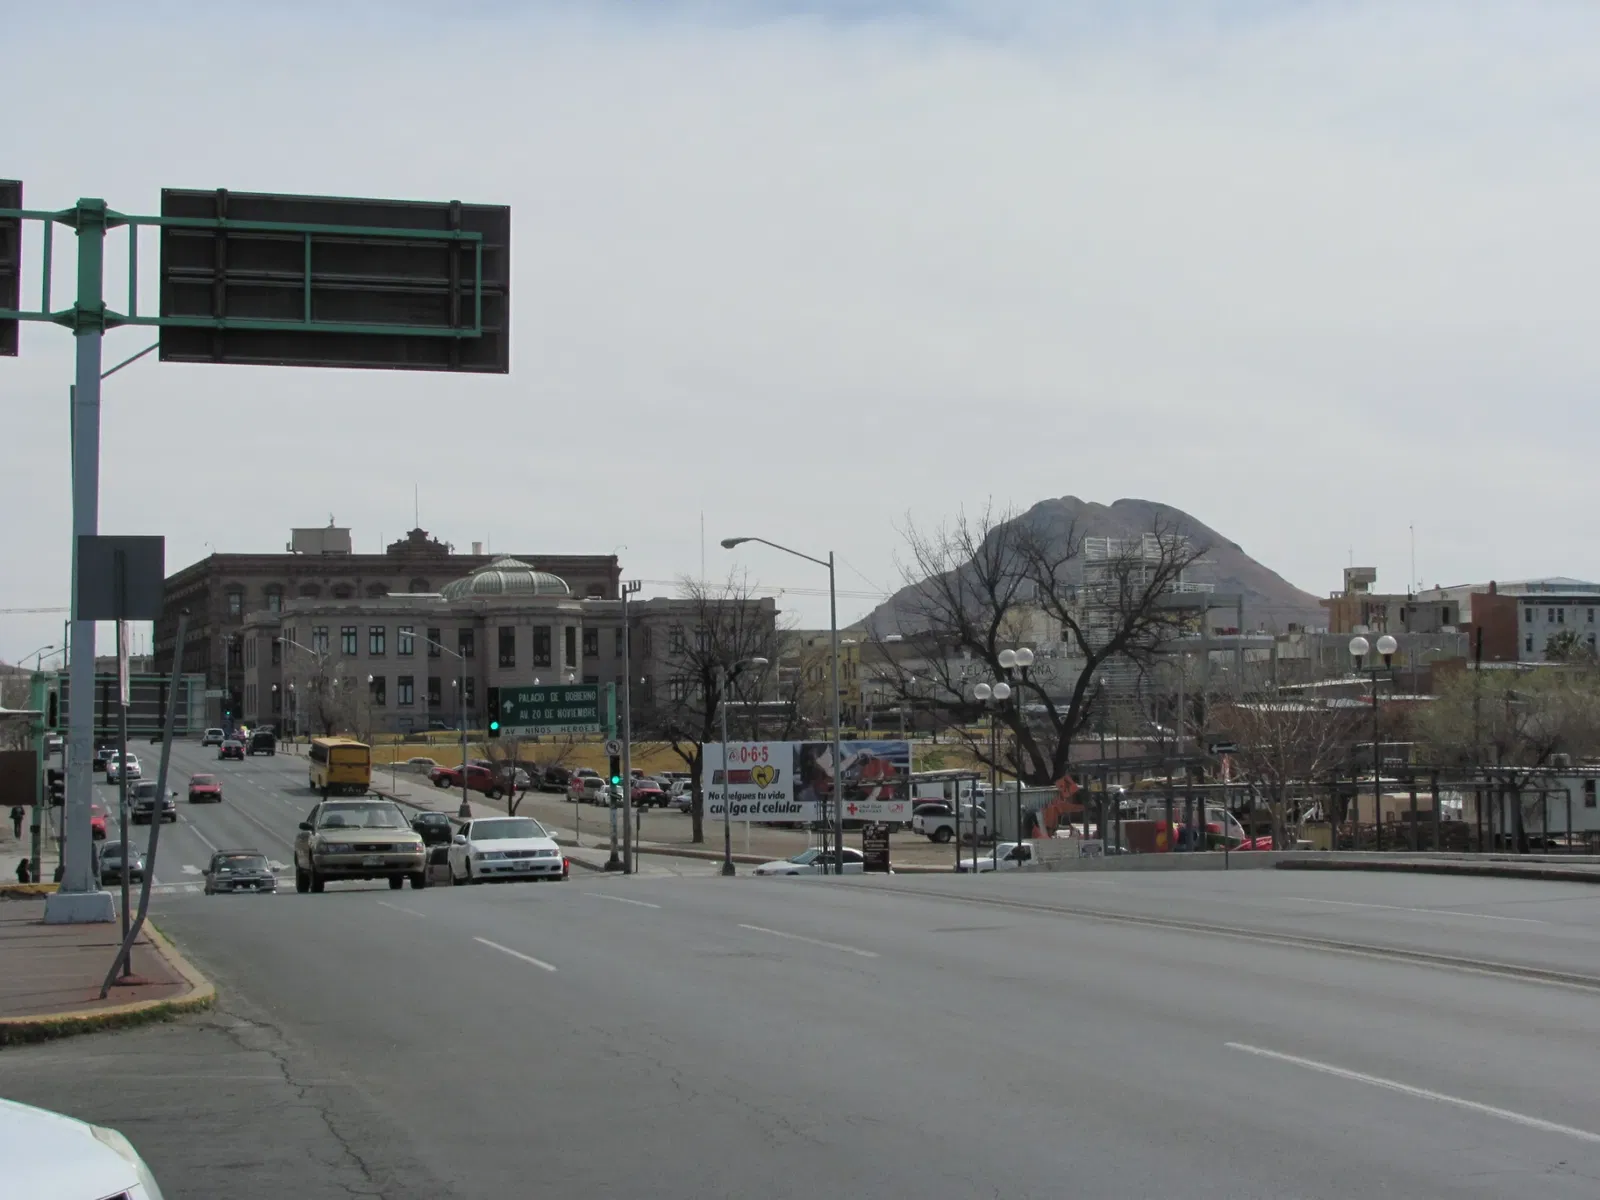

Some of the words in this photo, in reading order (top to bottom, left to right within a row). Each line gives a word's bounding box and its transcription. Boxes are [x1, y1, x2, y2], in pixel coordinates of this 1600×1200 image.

[518, 692, 544, 702] PALACIO
[550, 692, 559, 702] DE
[565, 691, 596, 702] GOBIERNO
[532, 709, 542, 720] 20
[544, 708, 554, 719] DE
[557, 708, 596, 718] NOVIEMBRE
[708, 791, 720, 801] No
[721, 791, 756, 802] celgues
[757, 791, 766, 800] tu
[768, 790, 786, 800] vida
[749, 801, 760, 814] el
[762, 801, 802, 814] celular
